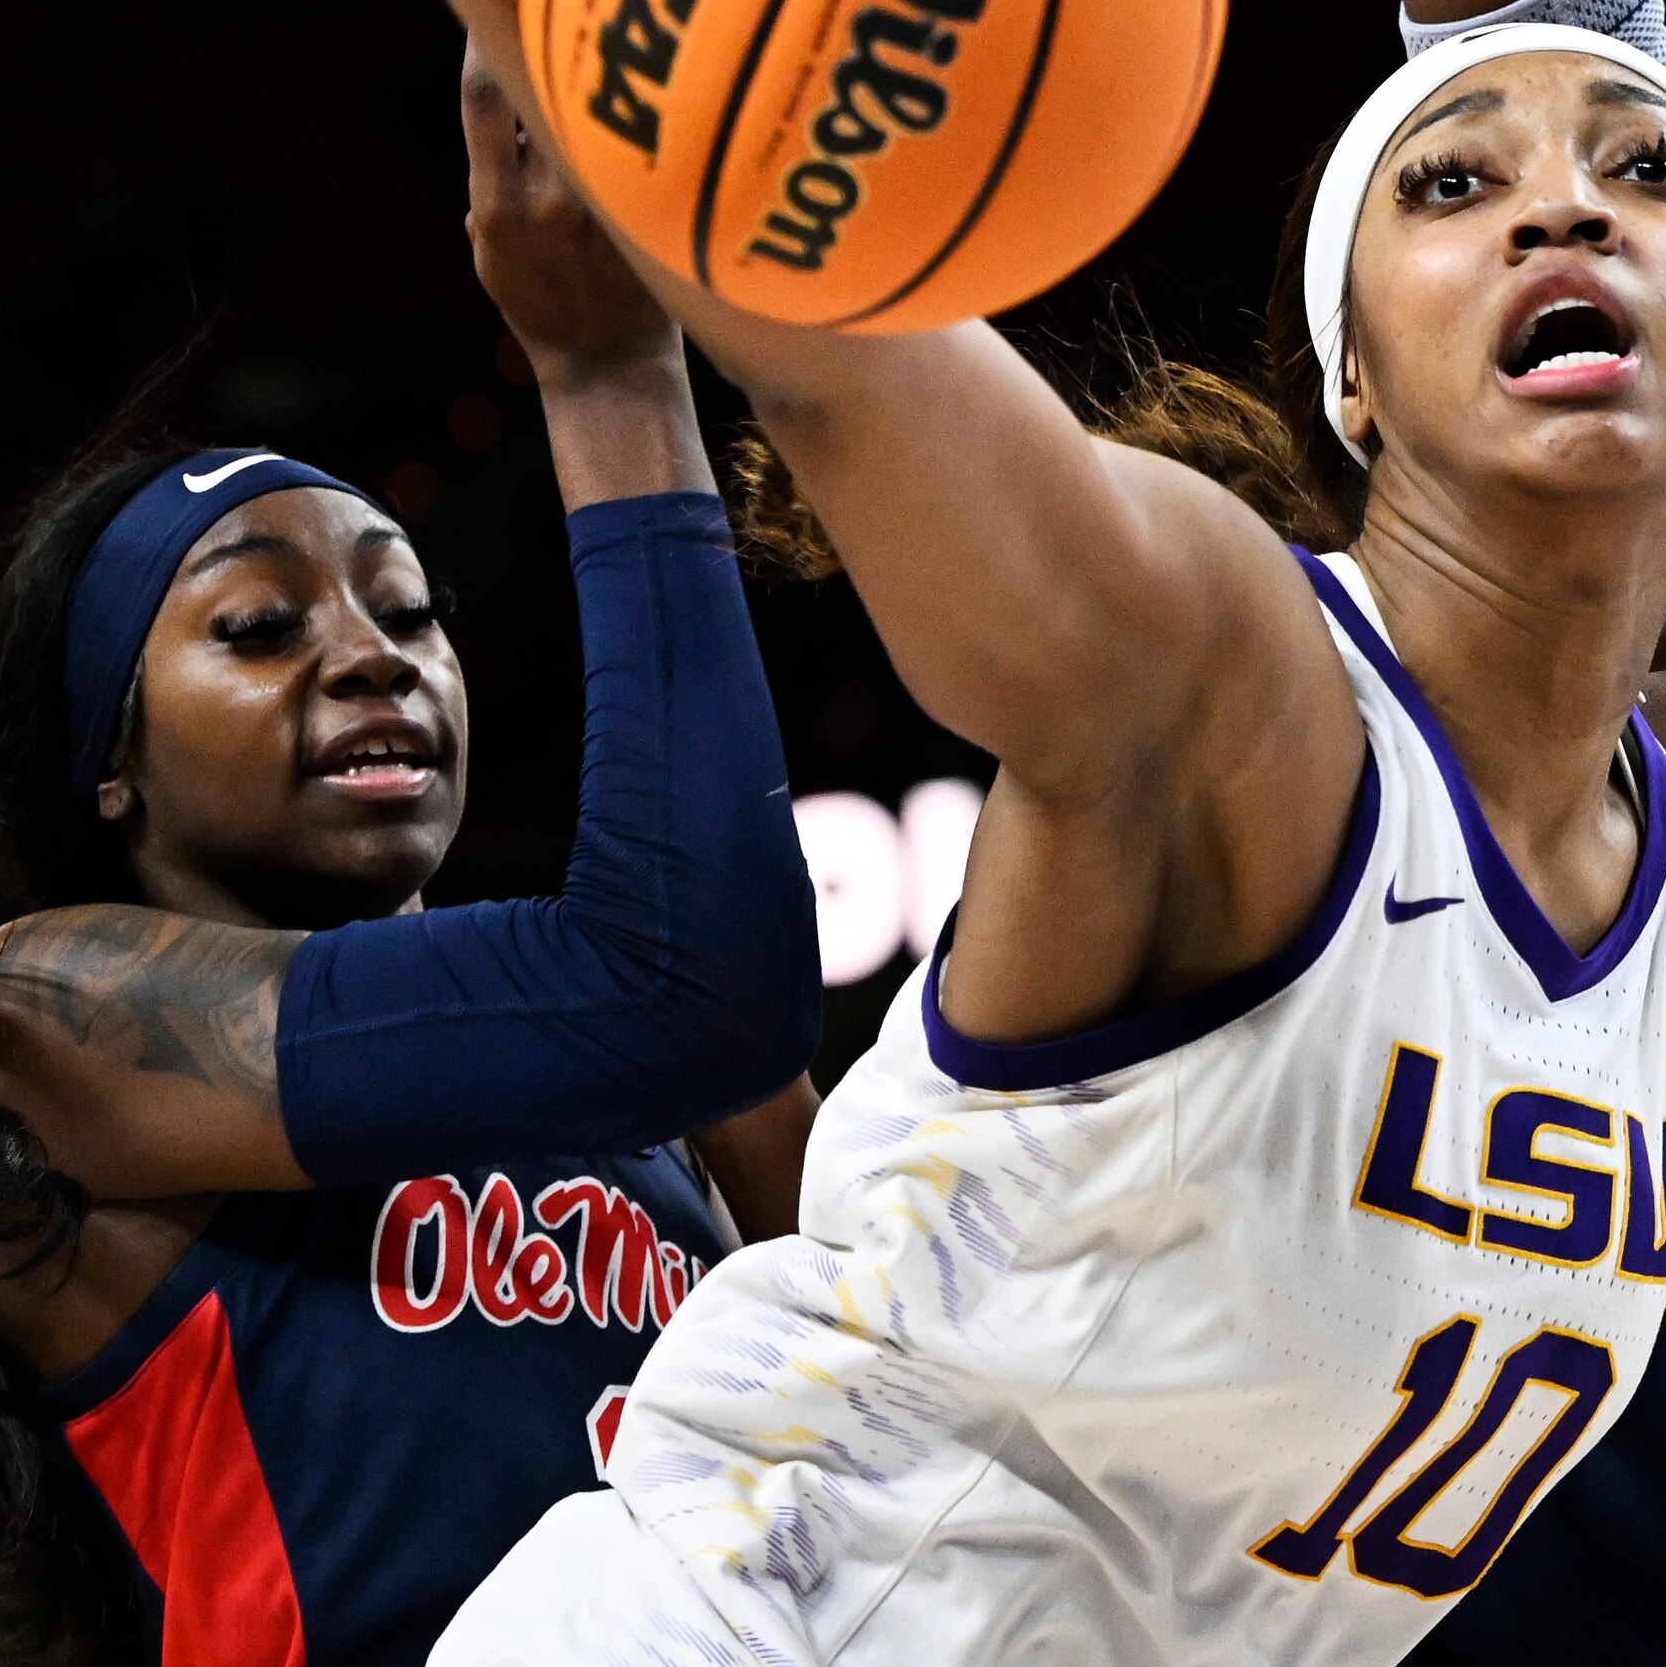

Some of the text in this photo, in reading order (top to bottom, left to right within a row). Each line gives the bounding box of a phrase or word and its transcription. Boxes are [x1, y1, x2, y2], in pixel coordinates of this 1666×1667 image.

[370, 1172, 708, 1334] Ole Mi
[1246, 1312, 1618, 1602] 10
